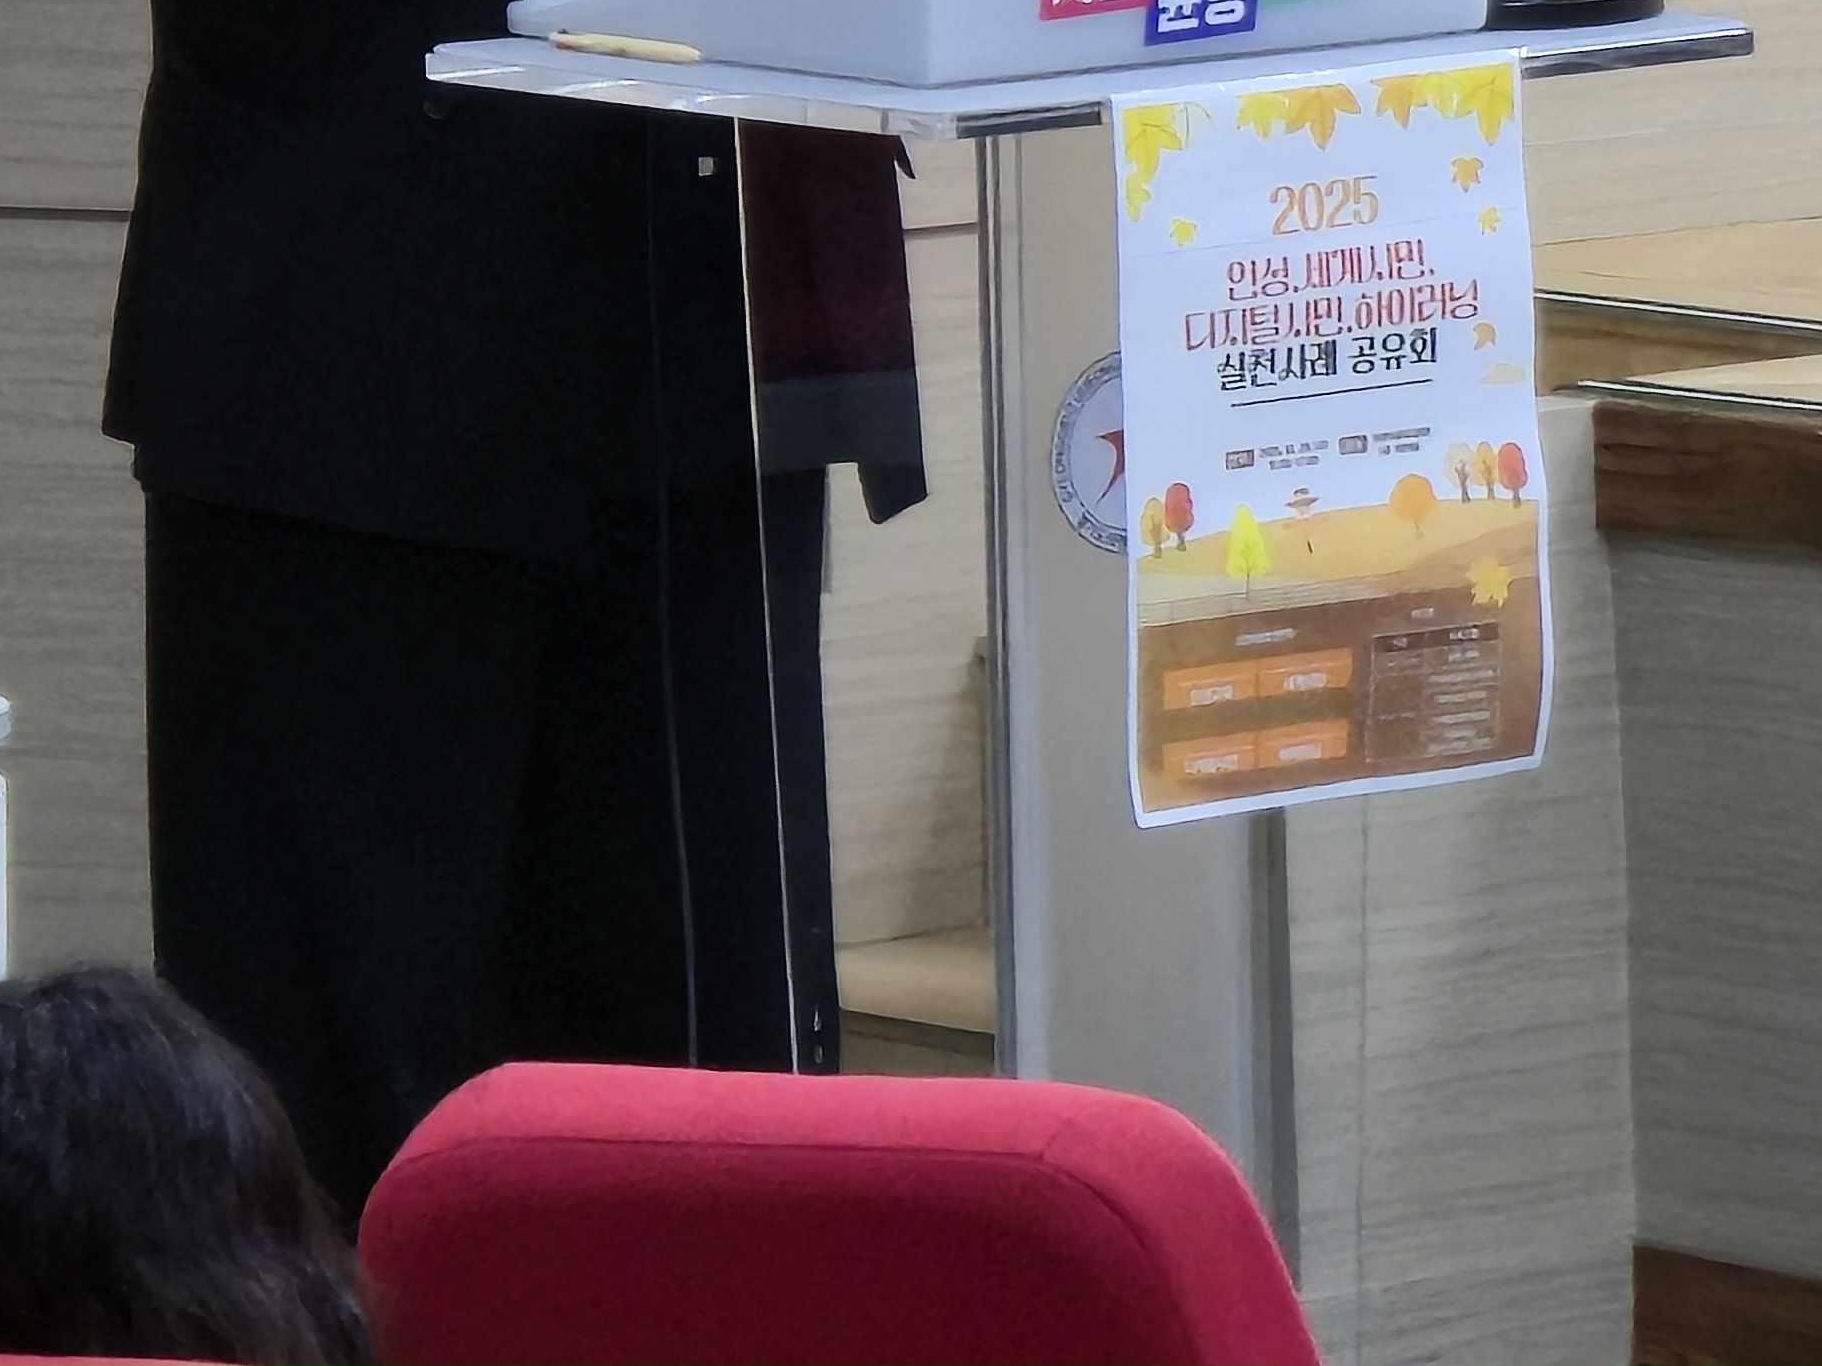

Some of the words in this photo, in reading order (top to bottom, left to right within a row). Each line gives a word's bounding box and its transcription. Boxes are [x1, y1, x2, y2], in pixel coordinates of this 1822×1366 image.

[1269, 175, 1379, 235] 2025
[1217, 339, 1338, 391] 실천사례
[1347, 326, 1438, 374] 공유회
